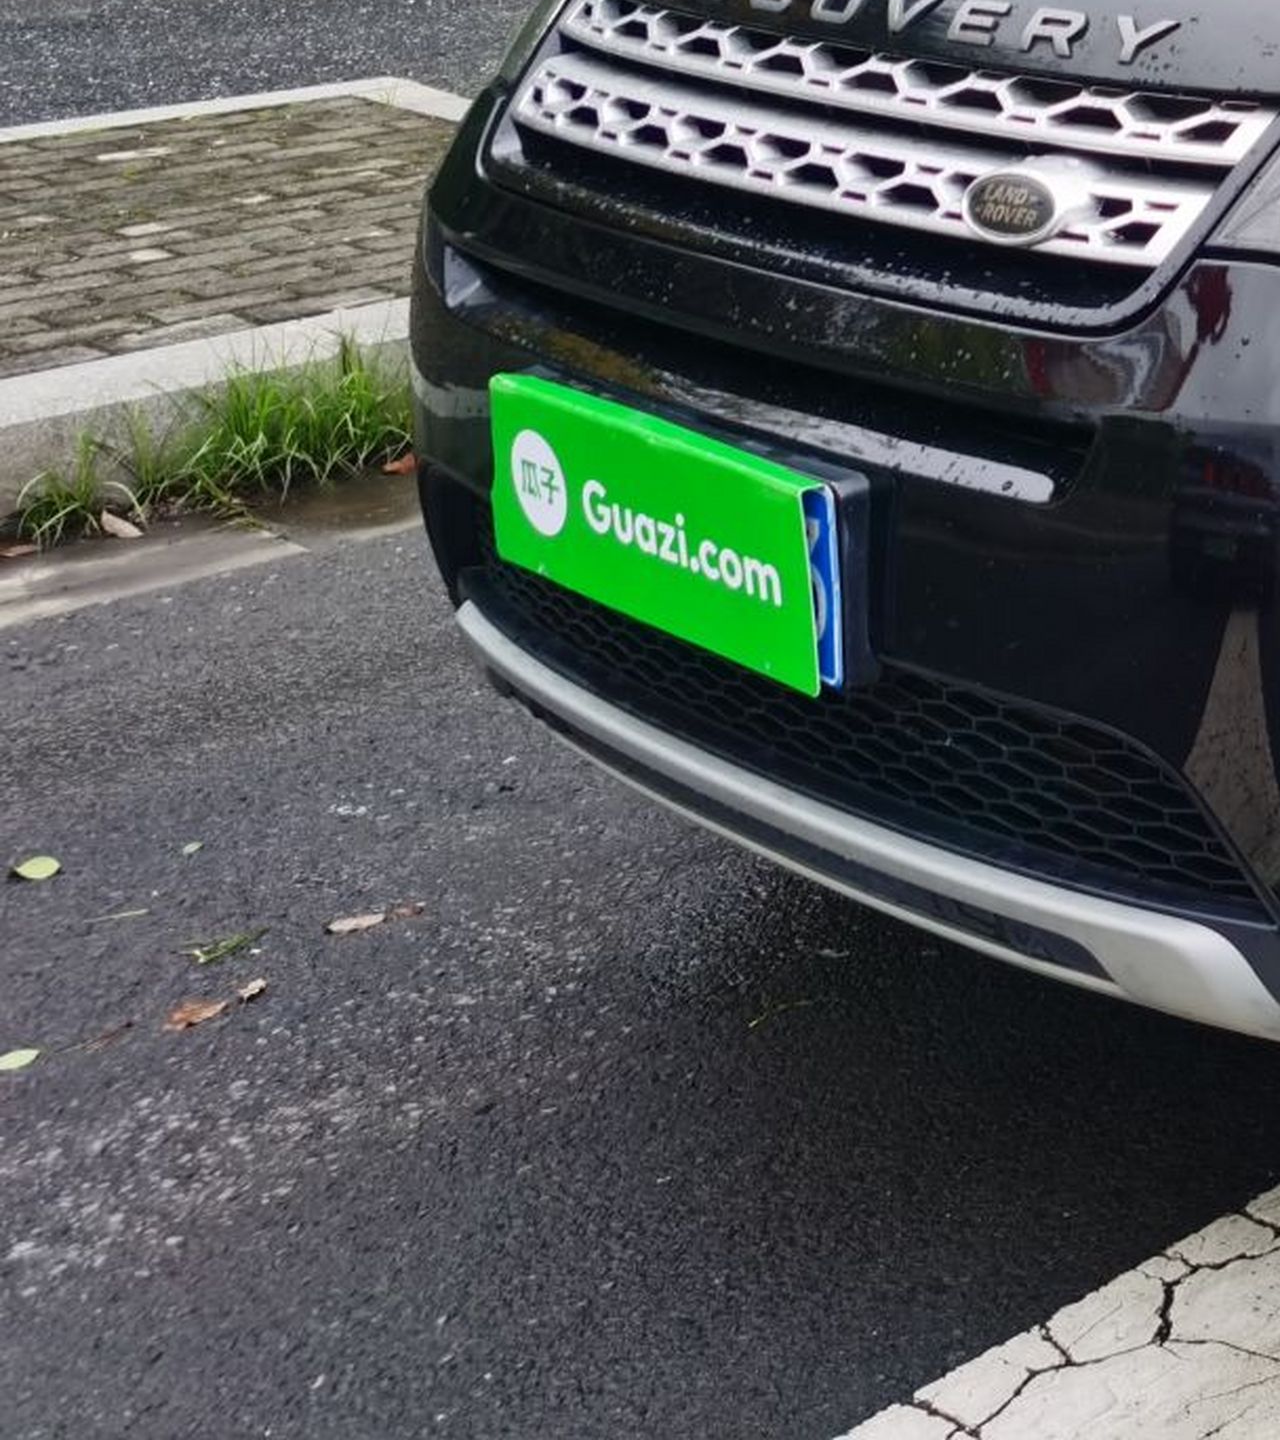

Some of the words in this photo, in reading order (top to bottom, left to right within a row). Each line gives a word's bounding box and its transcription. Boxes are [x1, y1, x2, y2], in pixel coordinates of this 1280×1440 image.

[983, 182, 1029, 206] LAND
[980, 202, 1038, 227] ROVER
[520, 458, 560, 505] 瓜子
[581, 478, 782, 607] Guazi.com
